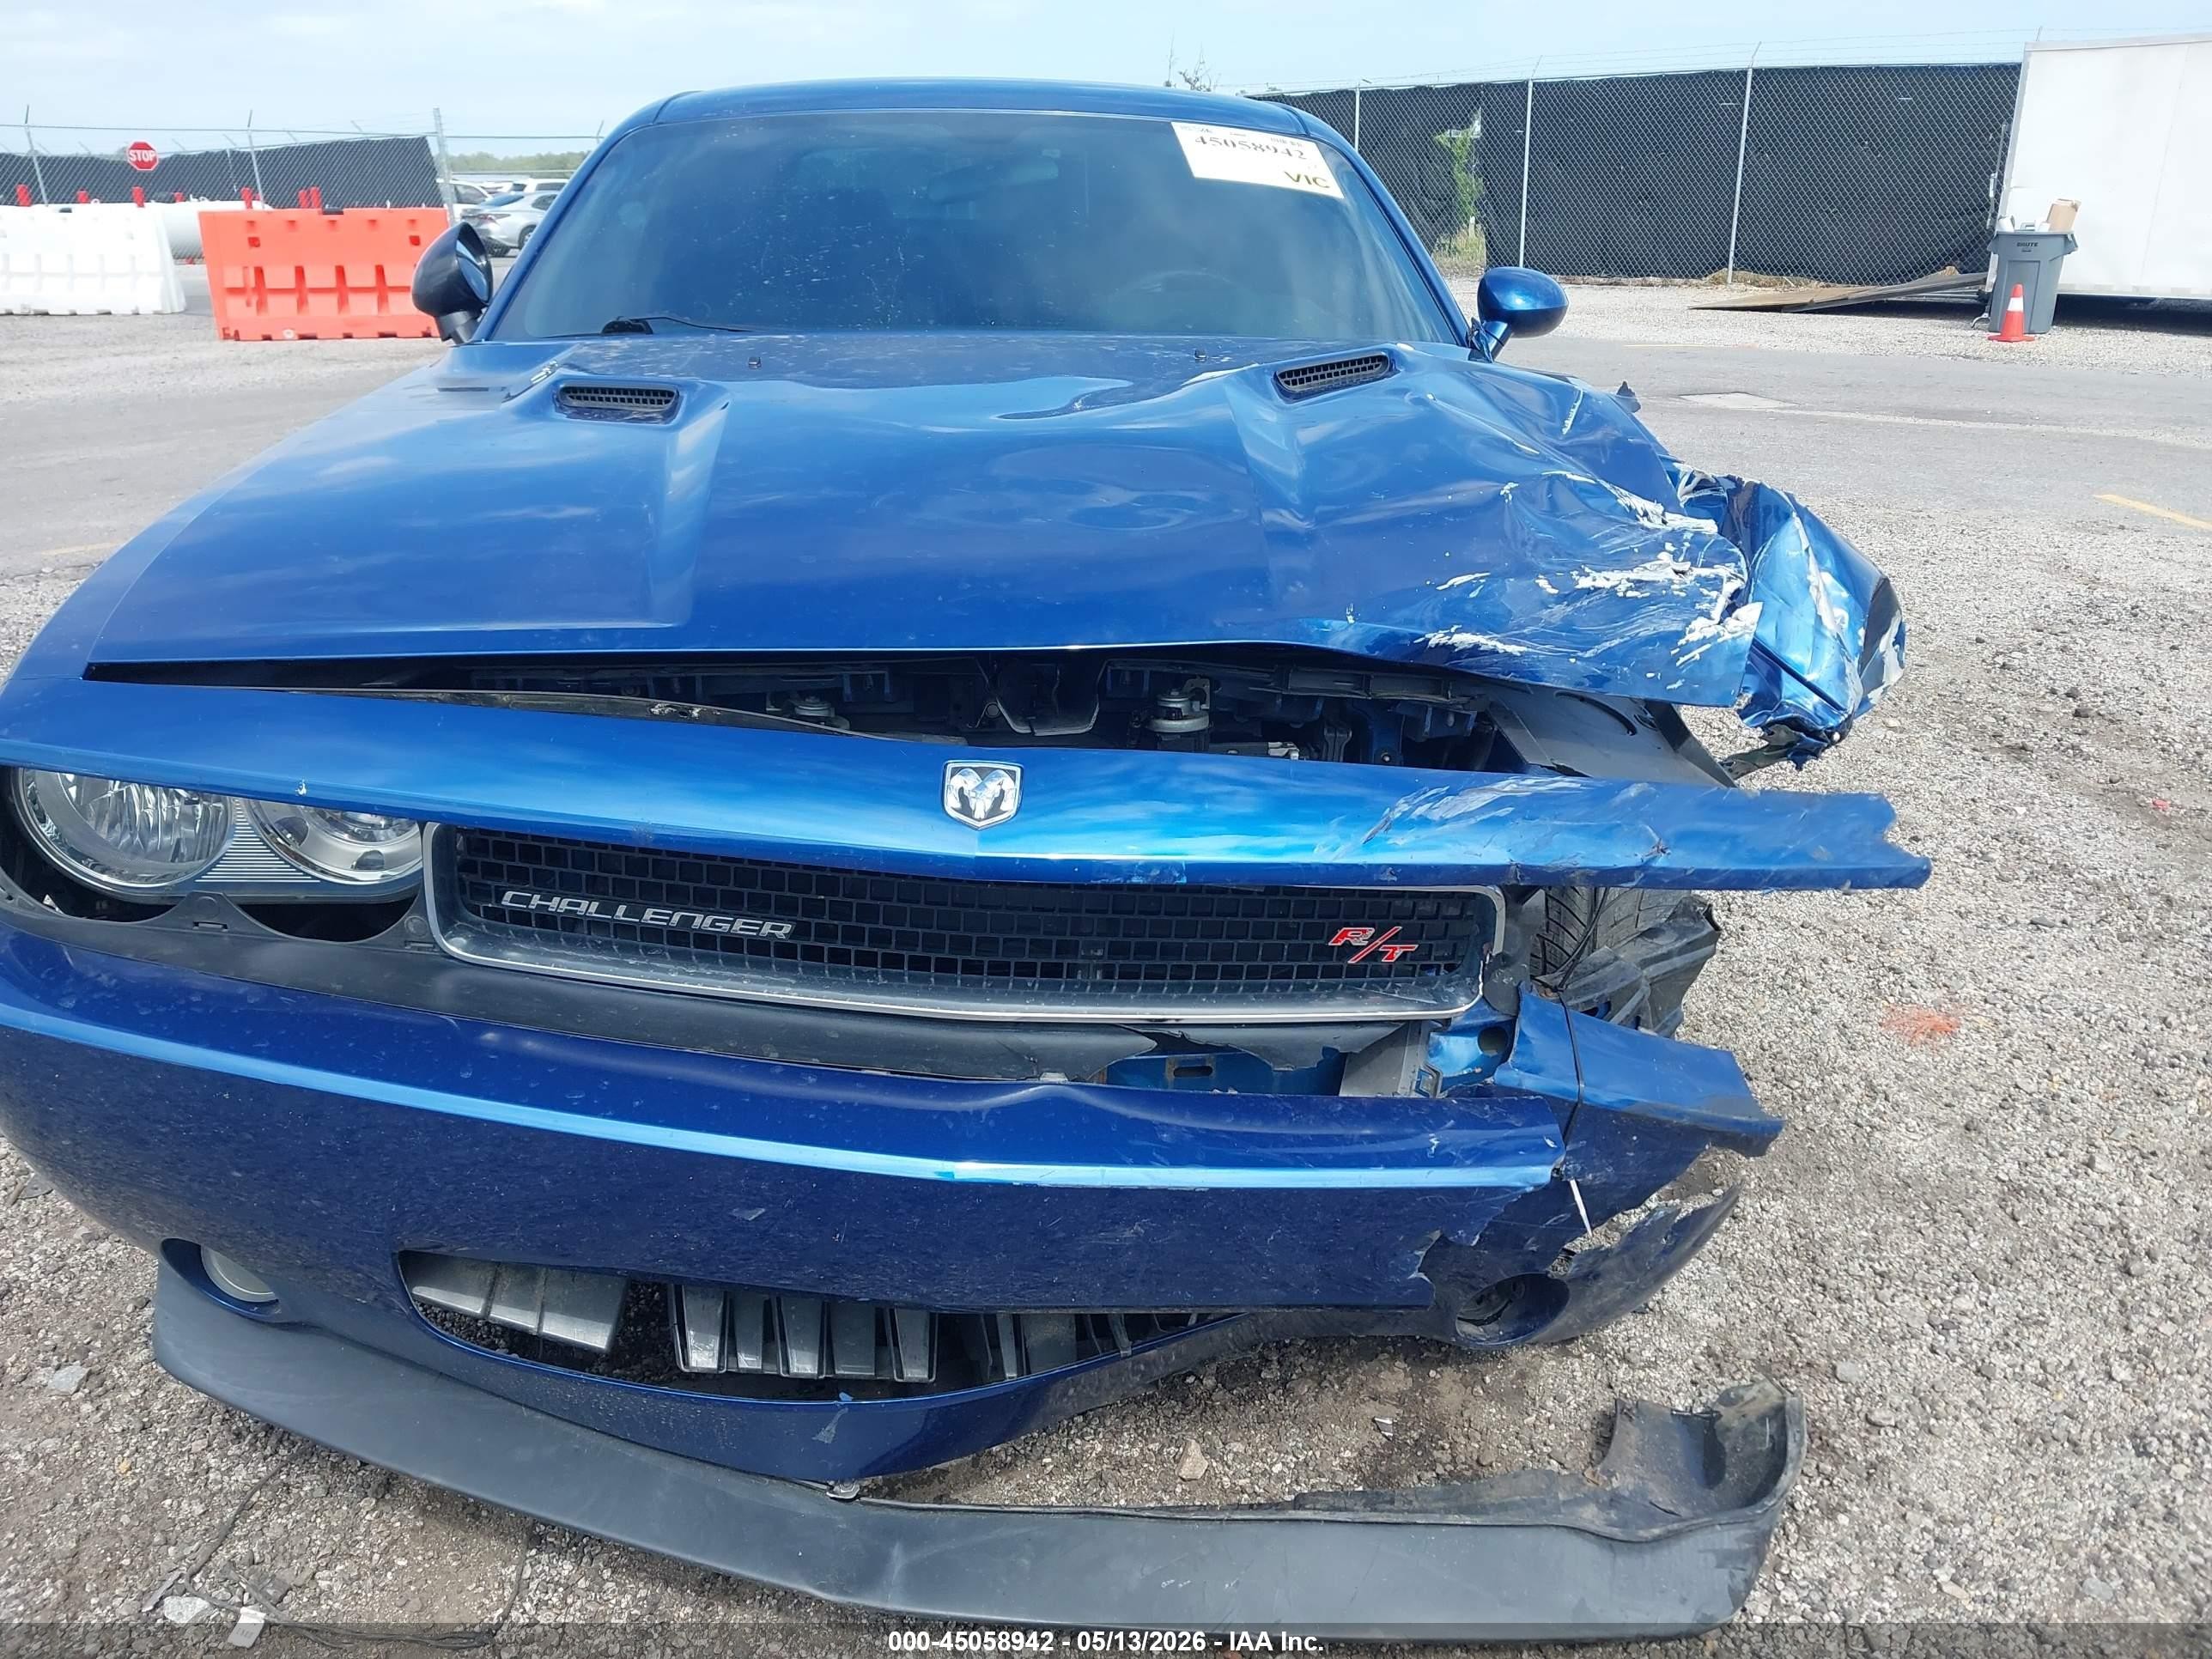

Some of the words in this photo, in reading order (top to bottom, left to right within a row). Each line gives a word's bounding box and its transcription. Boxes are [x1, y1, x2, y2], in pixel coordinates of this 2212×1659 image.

[129, 149, 155, 162] STOP
[1284, 171, 1331, 189] VIC
[501, 890, 793, 939] CHALLENGER
[1328, 927, 1419, 963] R/T
